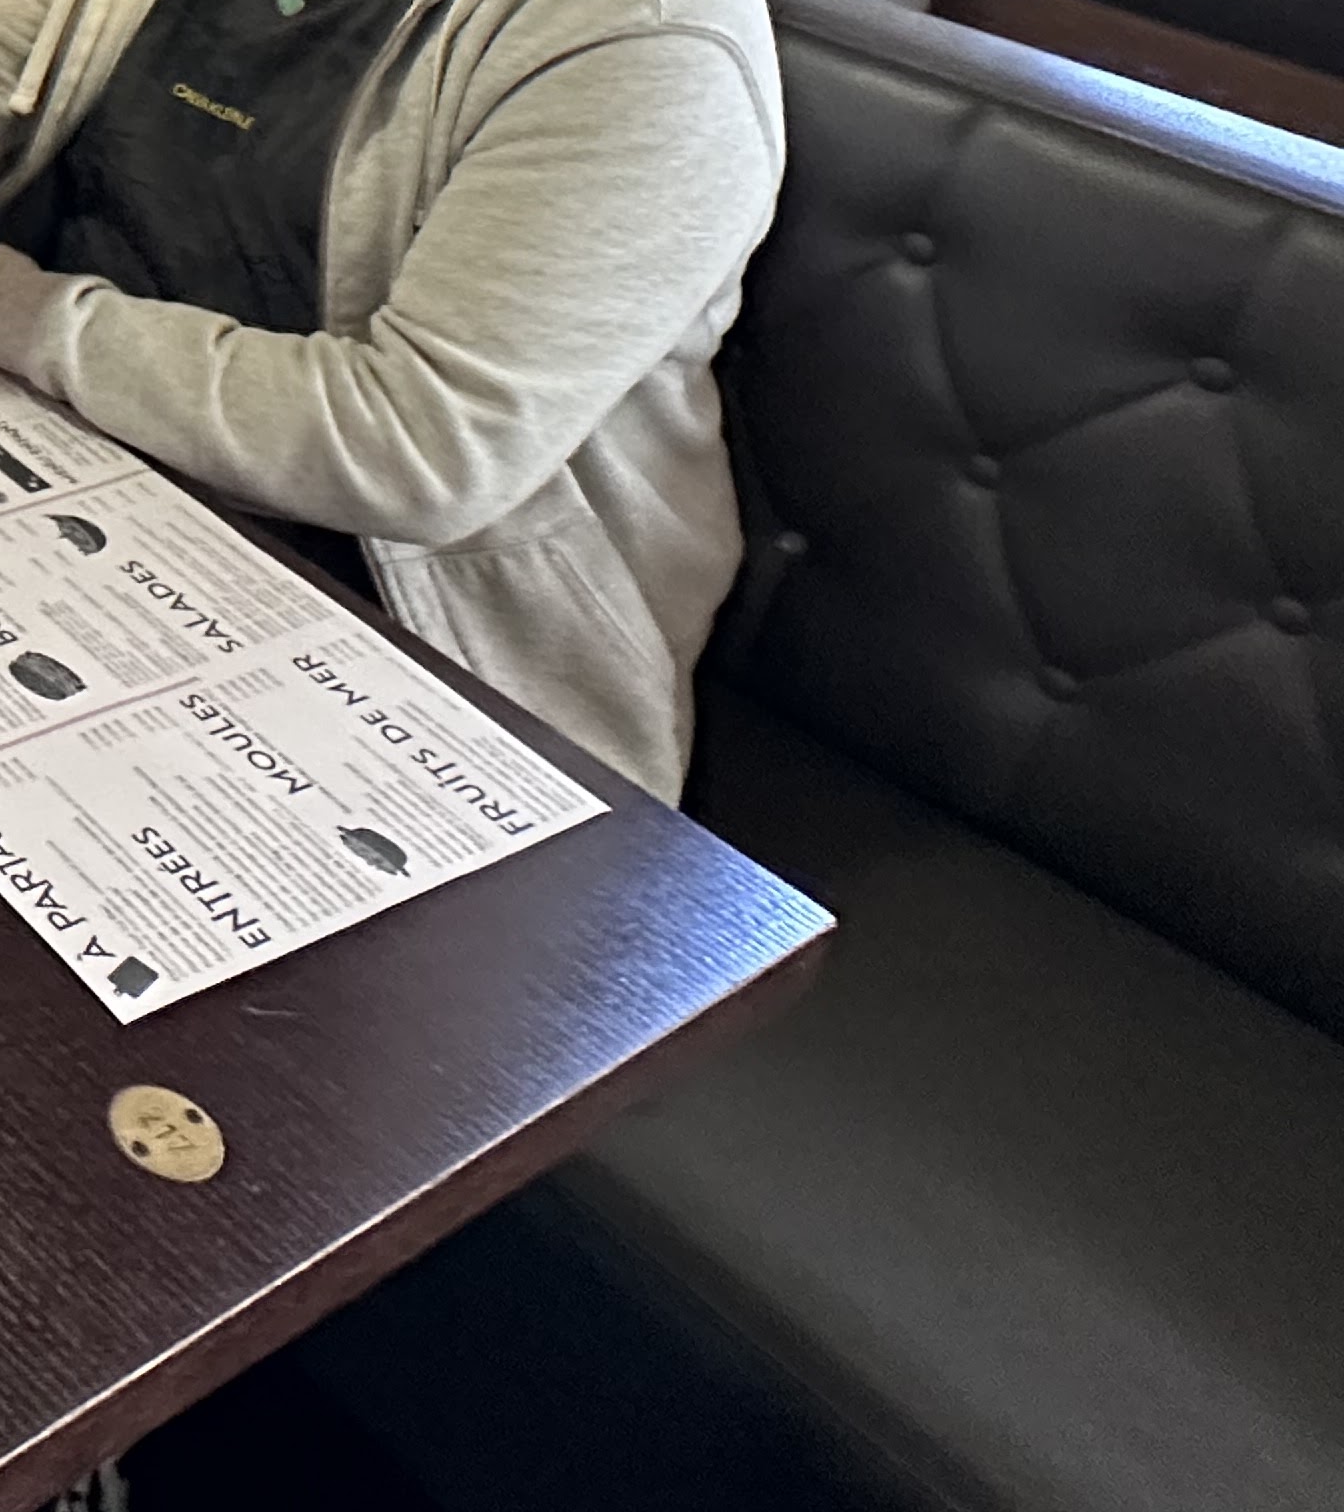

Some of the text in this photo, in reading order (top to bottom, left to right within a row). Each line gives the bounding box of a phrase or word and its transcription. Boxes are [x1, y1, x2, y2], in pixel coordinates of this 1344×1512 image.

[120, 561, 243, 653] SALADES
[179, 695, 312, 794] MOULES
[293, 655, 534, 835] FRUITS DE MER
[132, 827, 271, 948] ENTRÉES
[73, 934, 116, 962] À
